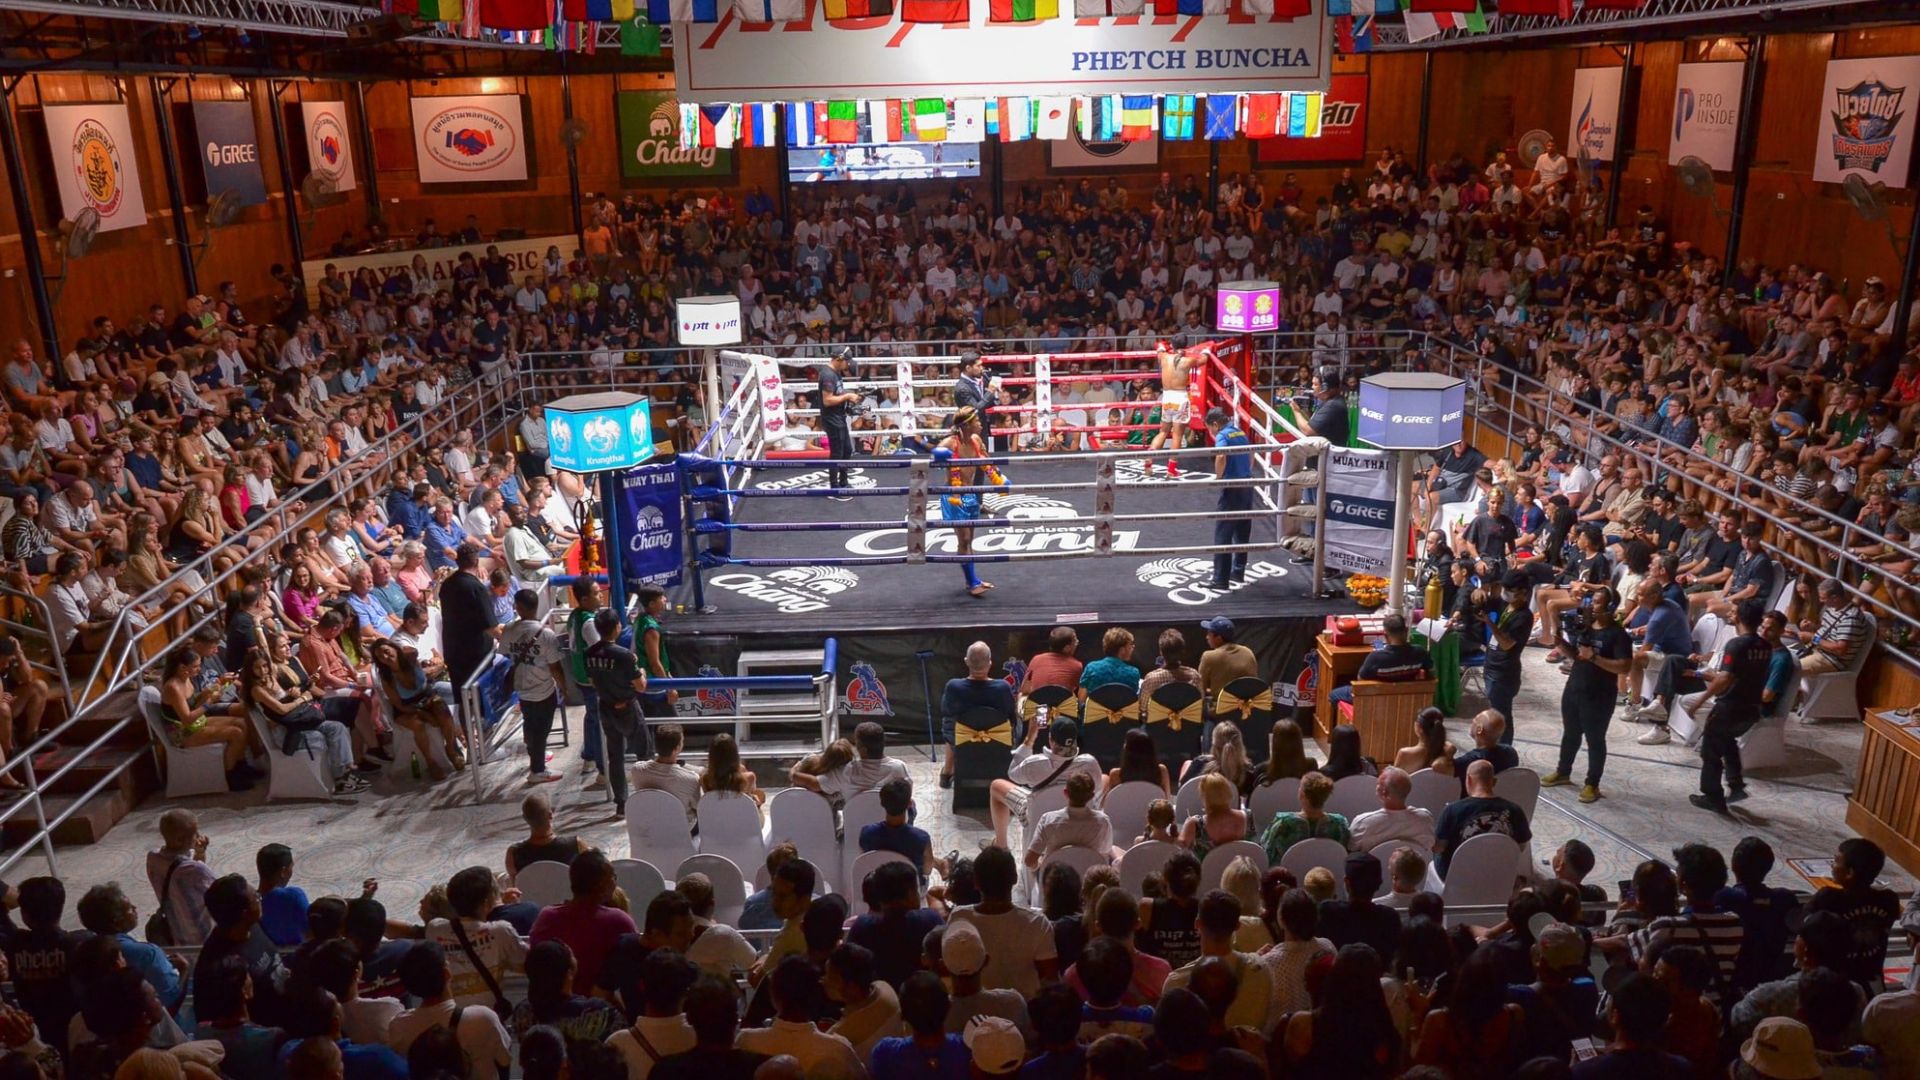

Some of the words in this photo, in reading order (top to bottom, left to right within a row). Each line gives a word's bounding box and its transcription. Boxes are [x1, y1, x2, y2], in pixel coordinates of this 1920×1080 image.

[1072, 50, 1186, 71] PHETCH
[1195, 48, 1310, 69] BUNCHA
[1699, 94, 1722, 108] PRO
[1697, 109, 1736, 125] INSIDE
[222, 144, 256, 164] GREE
[636, 139, 717, 168] Chang
[692, 321, 709, 331] ptt
[723, 319, 737, 329] ptt
[1251, 314, 1274, 325] GSB
[1367, 410, 1385, 422] GREE
[1403, 416, 1435, 424] GREE
[1446, 410, 1461, 421] GREE
[586, 454, 625, 465] Krungthai
[1333, 456, 1360, 468] MUAY
[1365, 459, 1389, 471] THAI
[623, 475, 647, 489] MUAY
[650, 472, 675, 484] THAI
[1345, 504, 1389, 520] GREE
[630, 532, 673, 552] Chang
[1341, 560, 1371, 571] STADIUM
[709, 573, 831, 613] Chang
